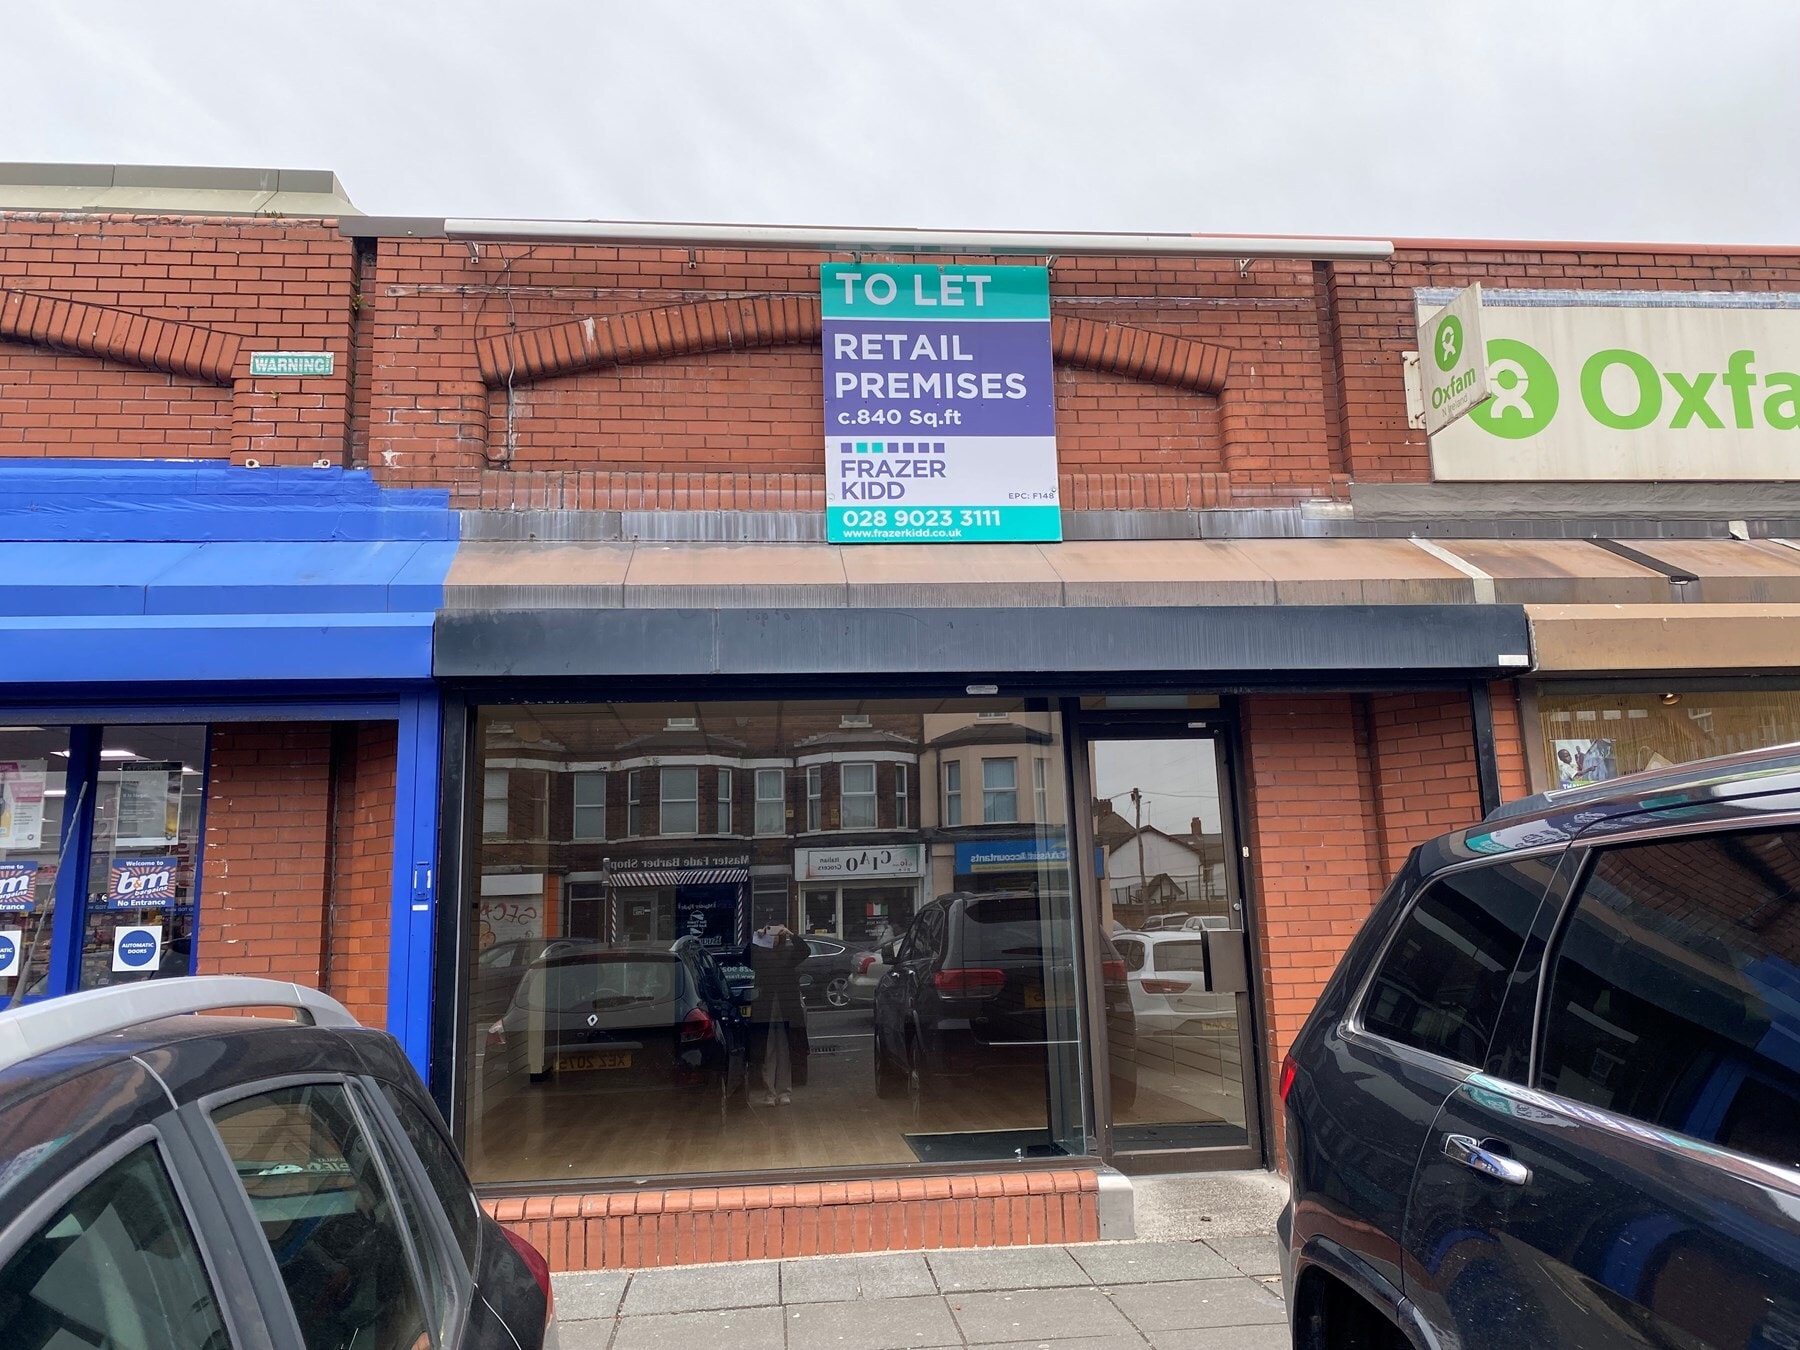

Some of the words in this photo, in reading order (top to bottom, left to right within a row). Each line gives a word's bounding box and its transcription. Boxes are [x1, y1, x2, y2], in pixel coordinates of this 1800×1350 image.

[835, 272, 898, 306] TO
[914, 274, 992, 307] LET
[834, 333, 974, 361] RETAIL
[255, 357, 330, 373] WARNING!
[835, 372, 1027, 399] PREMISES
[1432, 367, 1476, 410] Oxfam
[1448, 394, 1468, 414] Ireland
[837, 409, 902, 426] c.840
[909, 409, 962, 428] Sq.ft
[840, 460, 946, 478] FRAZER
[841, 482, 905, 500] KIDD
[1008, 492, 1031, 500] EPC:
[1033, 492, 1055, 500] F148
[843, 510, 887, 527] 028
[895, 510, 953, 527] 9023
[960, 509, 1001, 527] 3111
[843, 528, 962, 538] www.frazerkidd.co.uk
[117, 871, 169, 894] b&m
[134, 886, 168, 896] bargains
